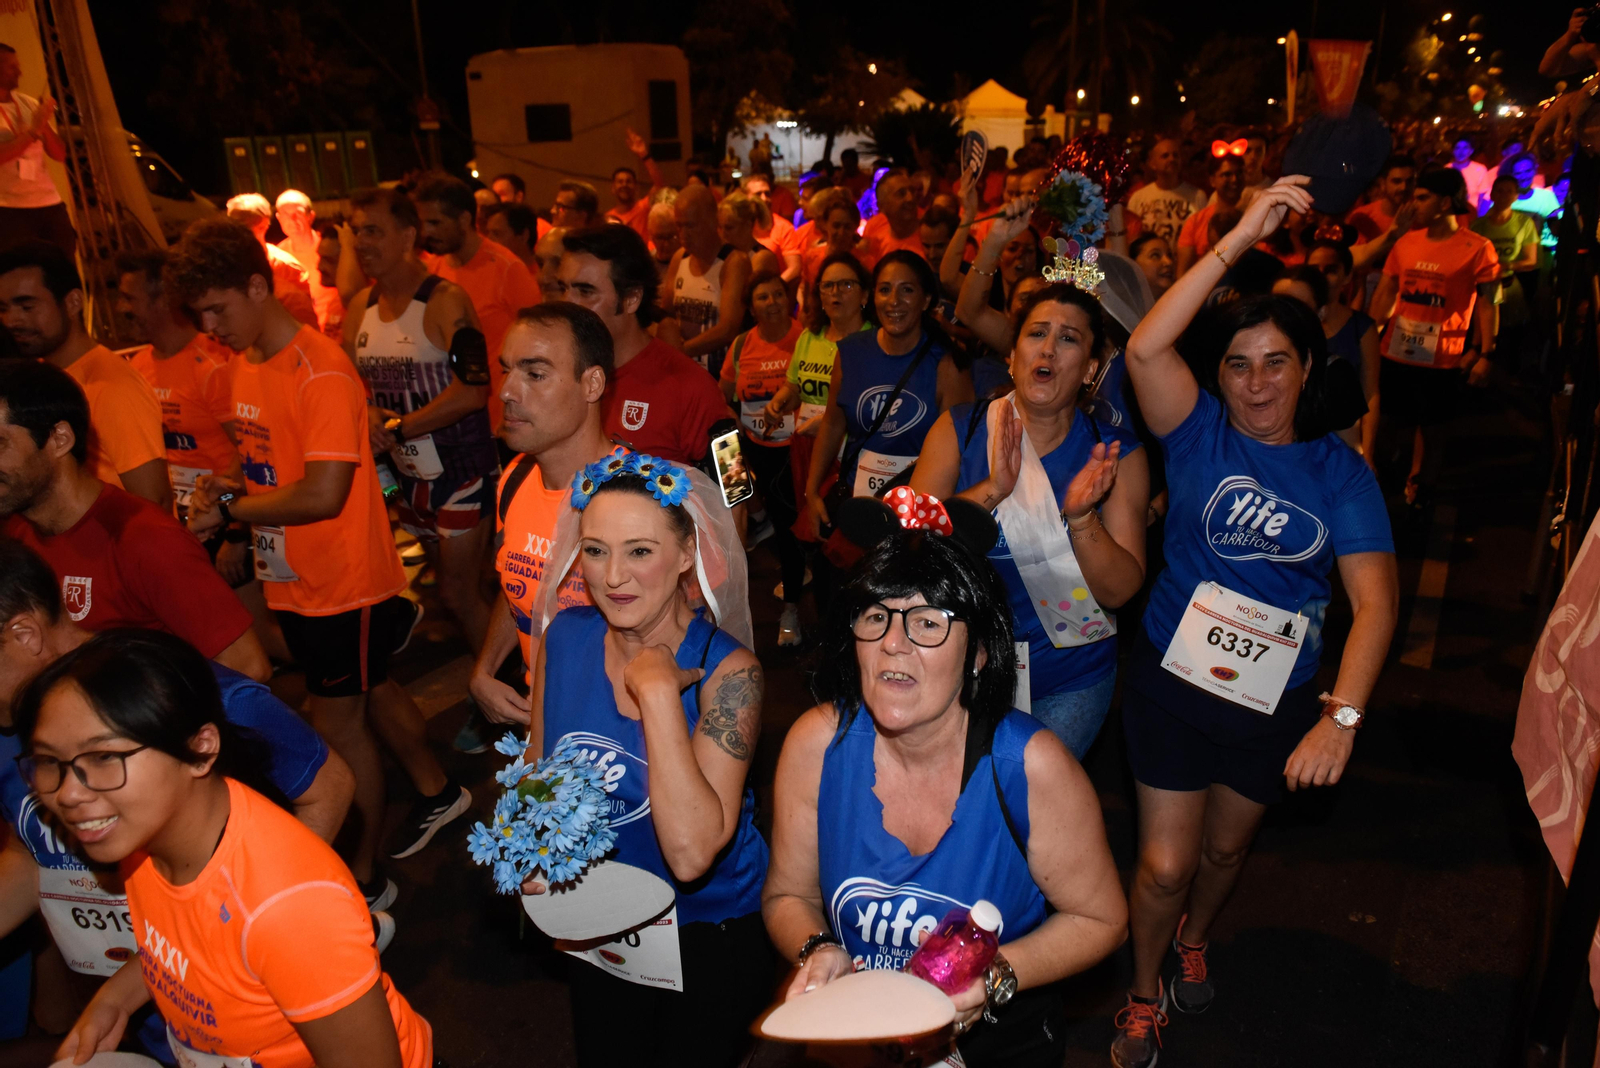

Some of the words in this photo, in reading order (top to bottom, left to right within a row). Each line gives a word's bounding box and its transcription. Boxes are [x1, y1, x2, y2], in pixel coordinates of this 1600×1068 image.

[359, 356, 414, 367] BUCKINGHAM
[761, 361, 787, 371] XXXV
[1226, 492, 1289, 536] life
[1212, 532, 1281, 554] CARREFOUR
[507, 552, 536, 567] CARRERA
[1207, 626, 1270, 662] 6337
[1241, 693, 1271, 707] Cruzcampo
[854, 897, 938, 947] life
[145, 919, 189, 982] XXXV
[892, 949, 914, 960] HACES
[639, 974, 676, 985] Cruzcampo
[163, 970, 215, 1013] NOCTURNA
